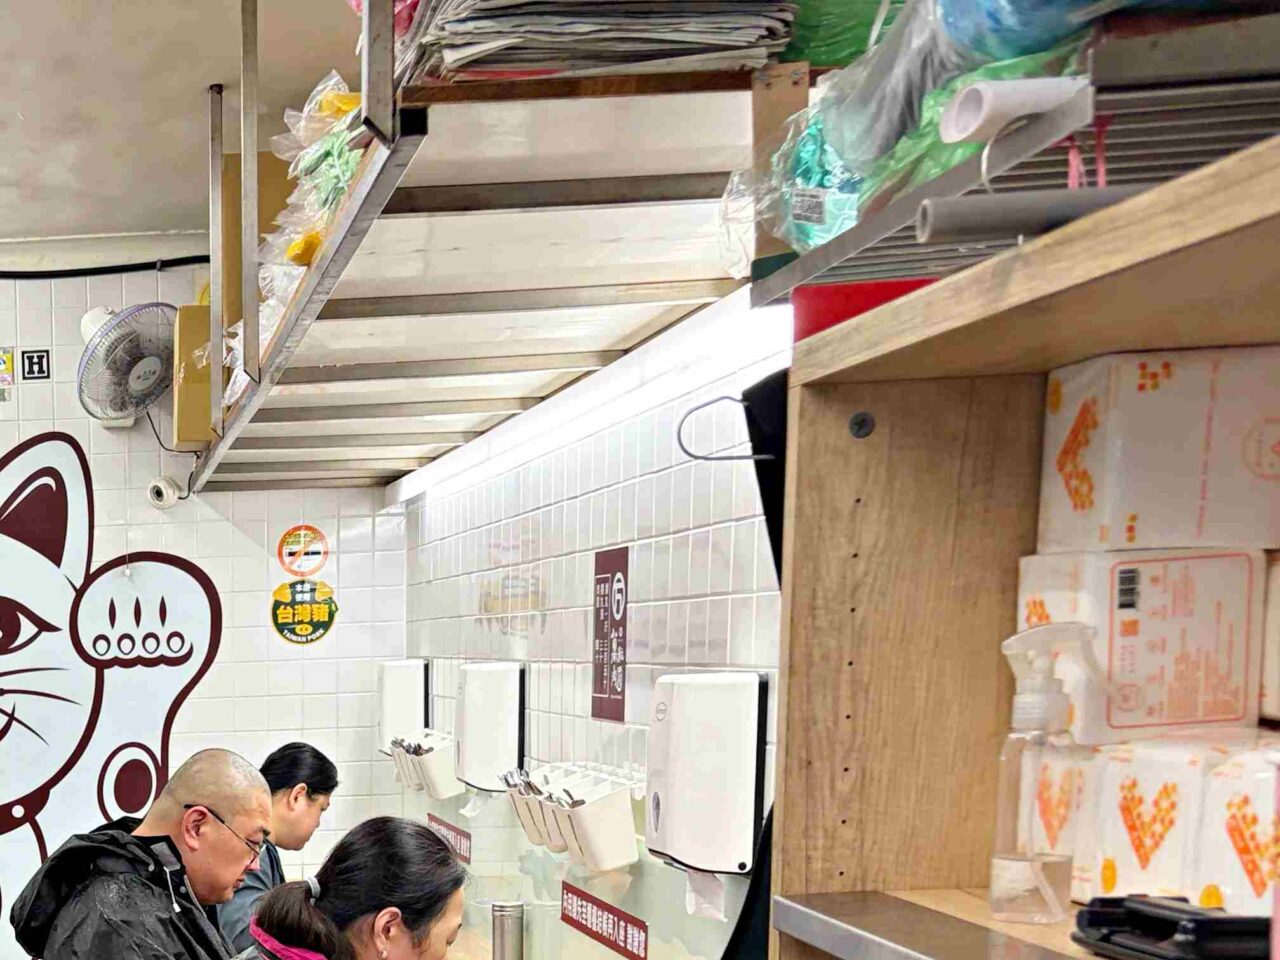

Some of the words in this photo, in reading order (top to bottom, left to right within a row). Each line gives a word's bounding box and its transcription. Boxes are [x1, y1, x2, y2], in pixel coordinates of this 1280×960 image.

[26, 354, 46, 375] H
[276, 603, 330, 624] 台灣豬
